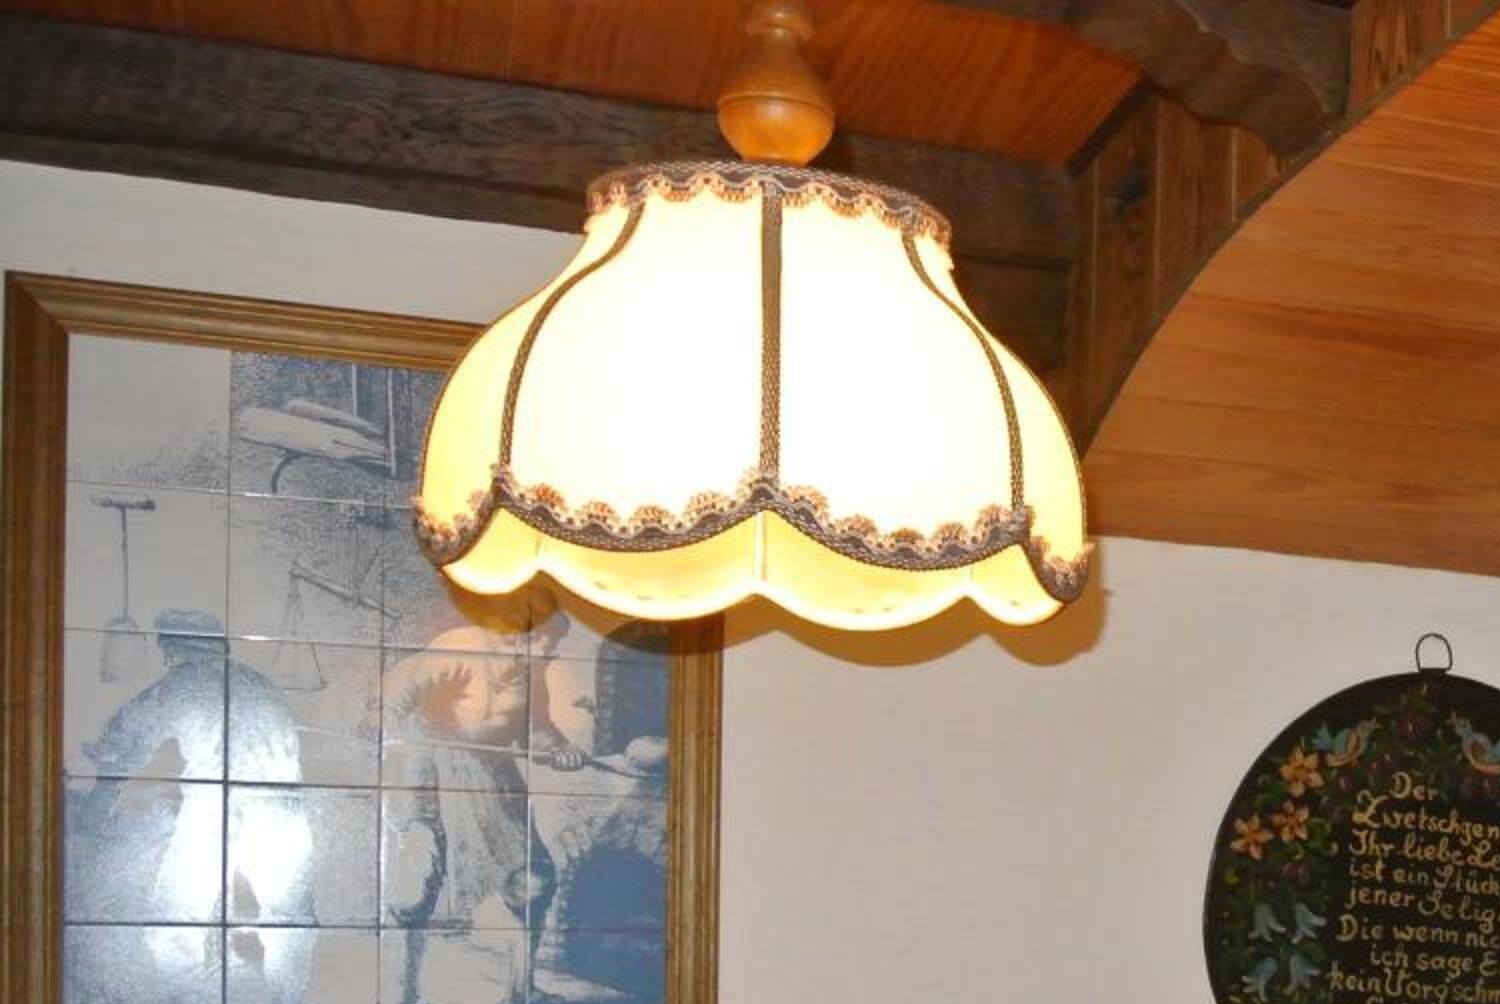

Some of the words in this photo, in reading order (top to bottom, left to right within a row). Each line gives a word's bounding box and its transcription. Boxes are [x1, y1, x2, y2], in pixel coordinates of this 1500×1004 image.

[1390, 771, 1440, 800] Der
[1349, 828, 1396, 859] Ihr
[1402, 832, 1465, 867] liebe
[1349, 858, 1385, 884] ist
[1393, 866, 1430, 886] ein
[1346, 885, 1414, 910] jener
[1336, 914, 1383, 942] Die
[1393, 922, 1459, 943] wenn
[1370, 943, 1409, 969] ich
[1415, 953, 1474, 980] sage
[1326, 960, 1383, 993] kein
